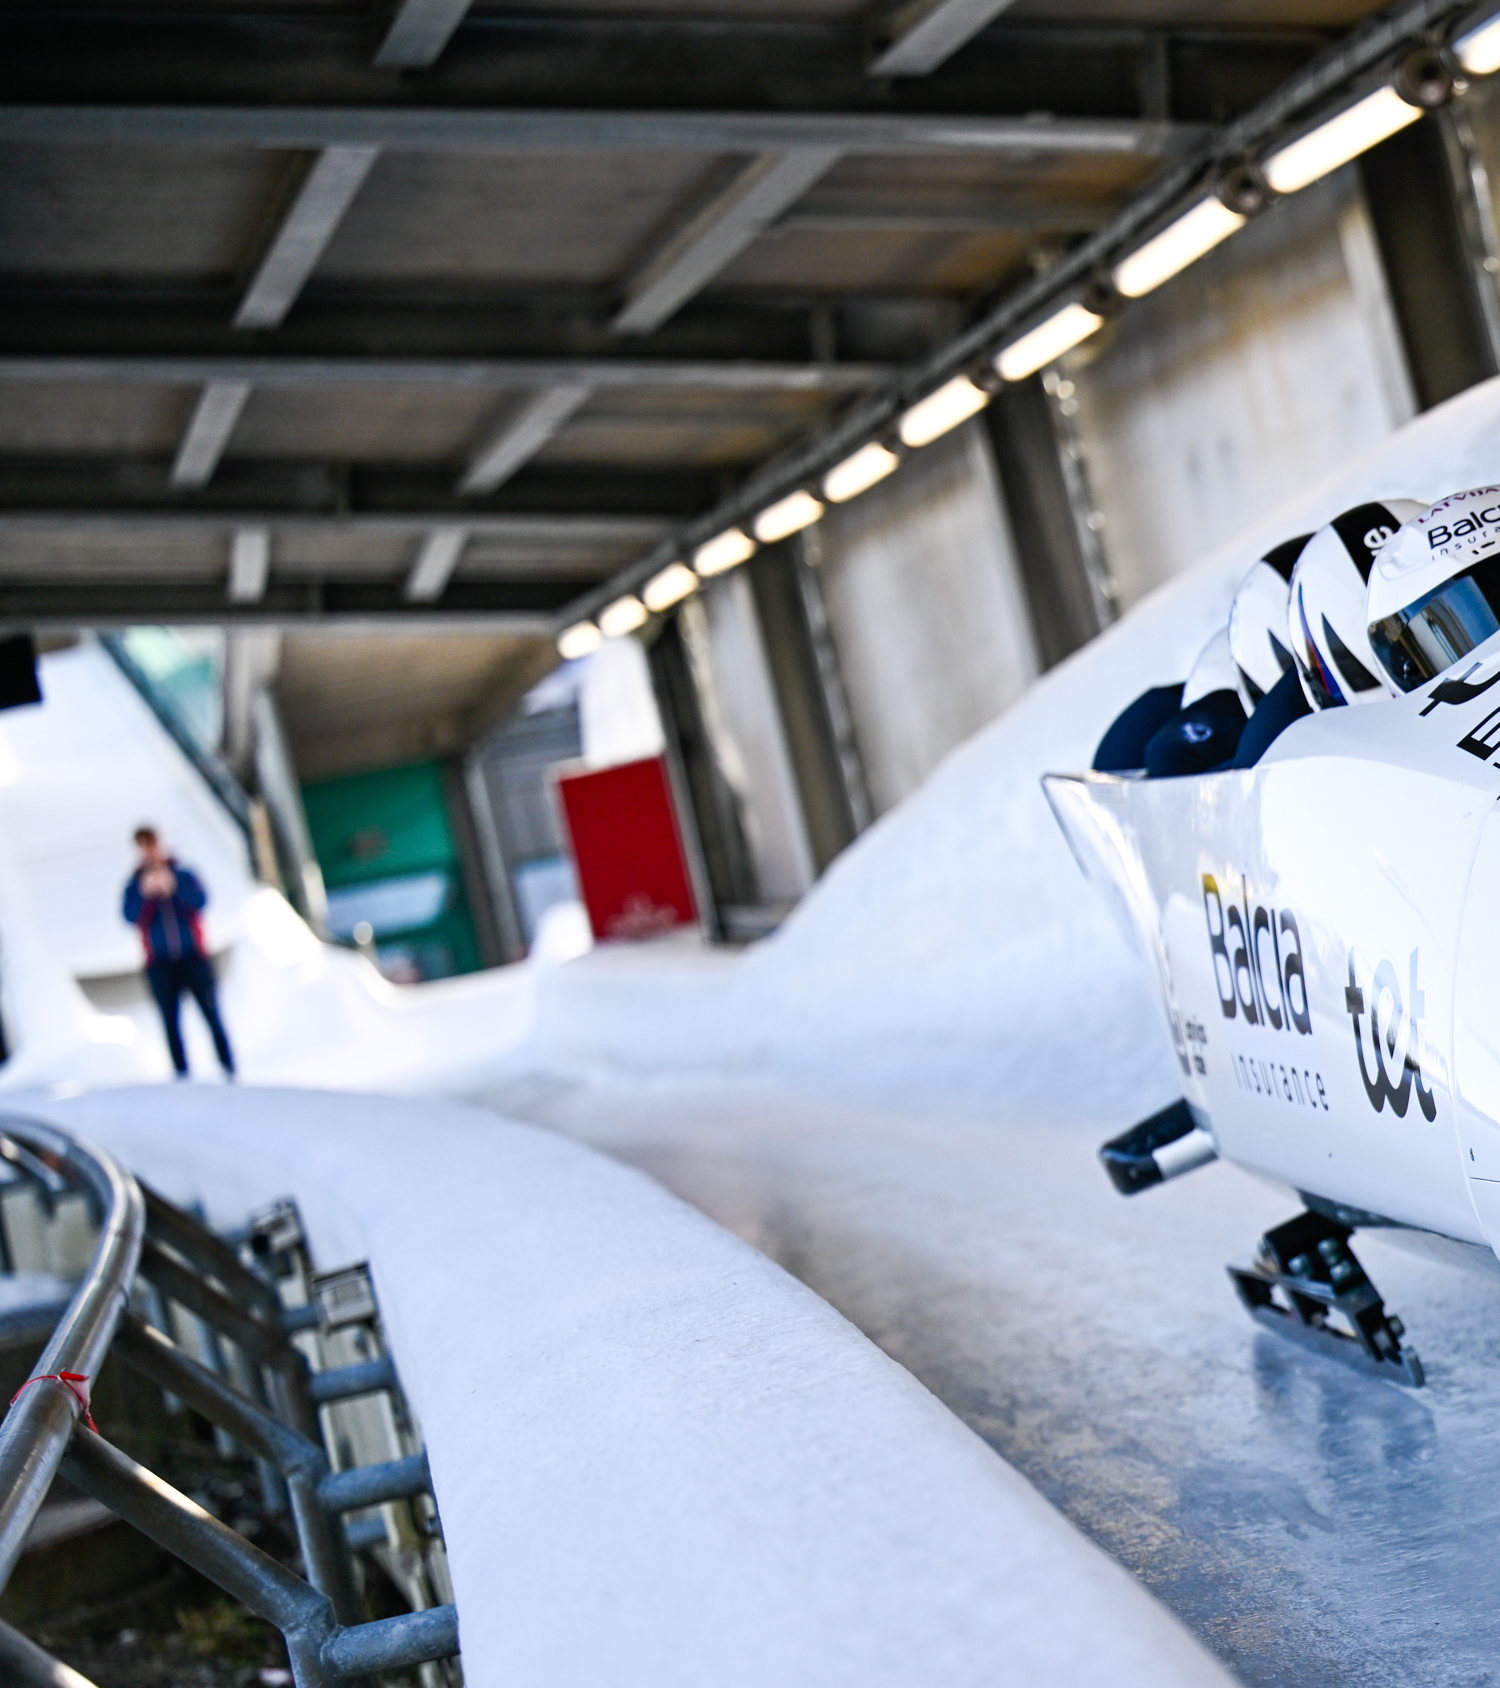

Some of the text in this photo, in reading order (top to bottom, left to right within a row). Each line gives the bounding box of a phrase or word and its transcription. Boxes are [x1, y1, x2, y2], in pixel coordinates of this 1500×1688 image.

[1202, 873, 1313, 1036] Balcia
[1344, 946, 1437, 1123] tet
[1230, 1054, 1329, 1111] insurance
